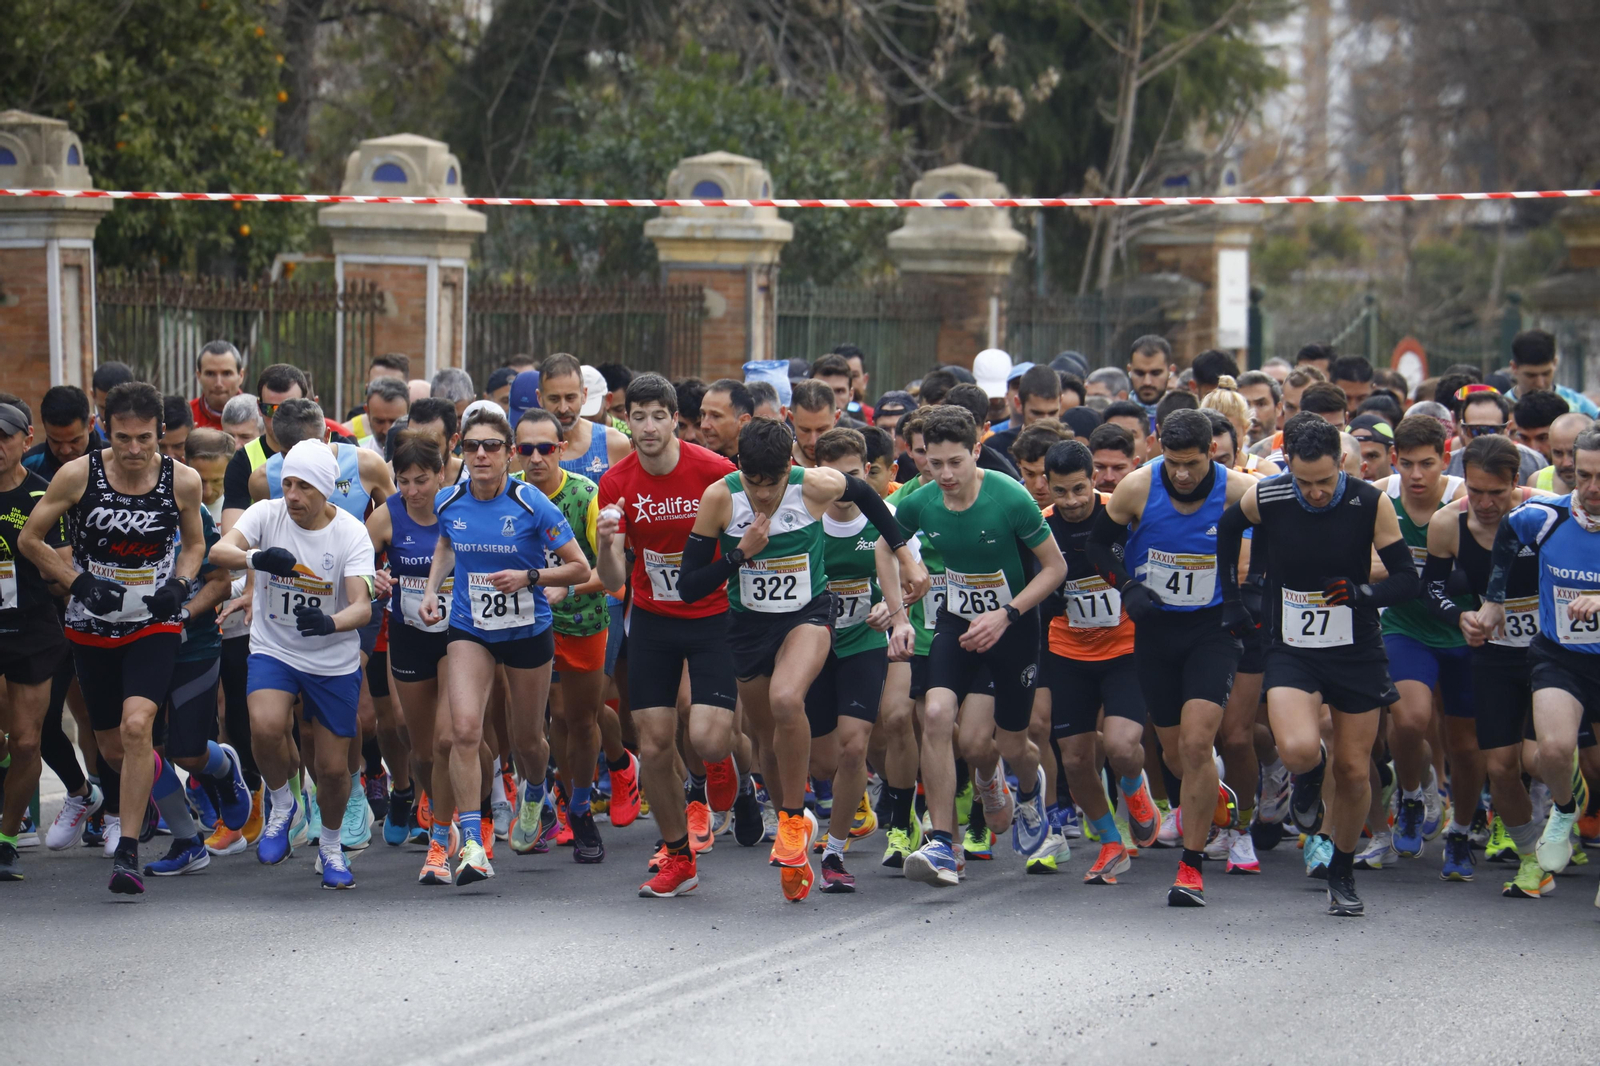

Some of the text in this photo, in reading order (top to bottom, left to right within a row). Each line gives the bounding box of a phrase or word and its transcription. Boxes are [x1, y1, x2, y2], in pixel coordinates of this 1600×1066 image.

[649, 497, 700, 515] califas
[85, 506, 166, 536] CORRE
[453, 542, 518, 553] TROTASIERRA
[1152, 551, 1176, 564] XXXIX
[91, 564, 115, 578] XXXIX
[400, 555, 434, 565] TROTA
[402, 577, 425, 589] XXXIX
[752, 575, 797, 601] 322
[1166, 571, 1193, 595] 41
[481, 592, 519, 618] 281
[958, 590, 1000, 614] 263
[1074, 592, 1113, 618] 171
[1284, 590, 1307, 603] XXXIX
[1301, 610, 1330, 635] 27
[1504, 614, 1537, 637] 33
